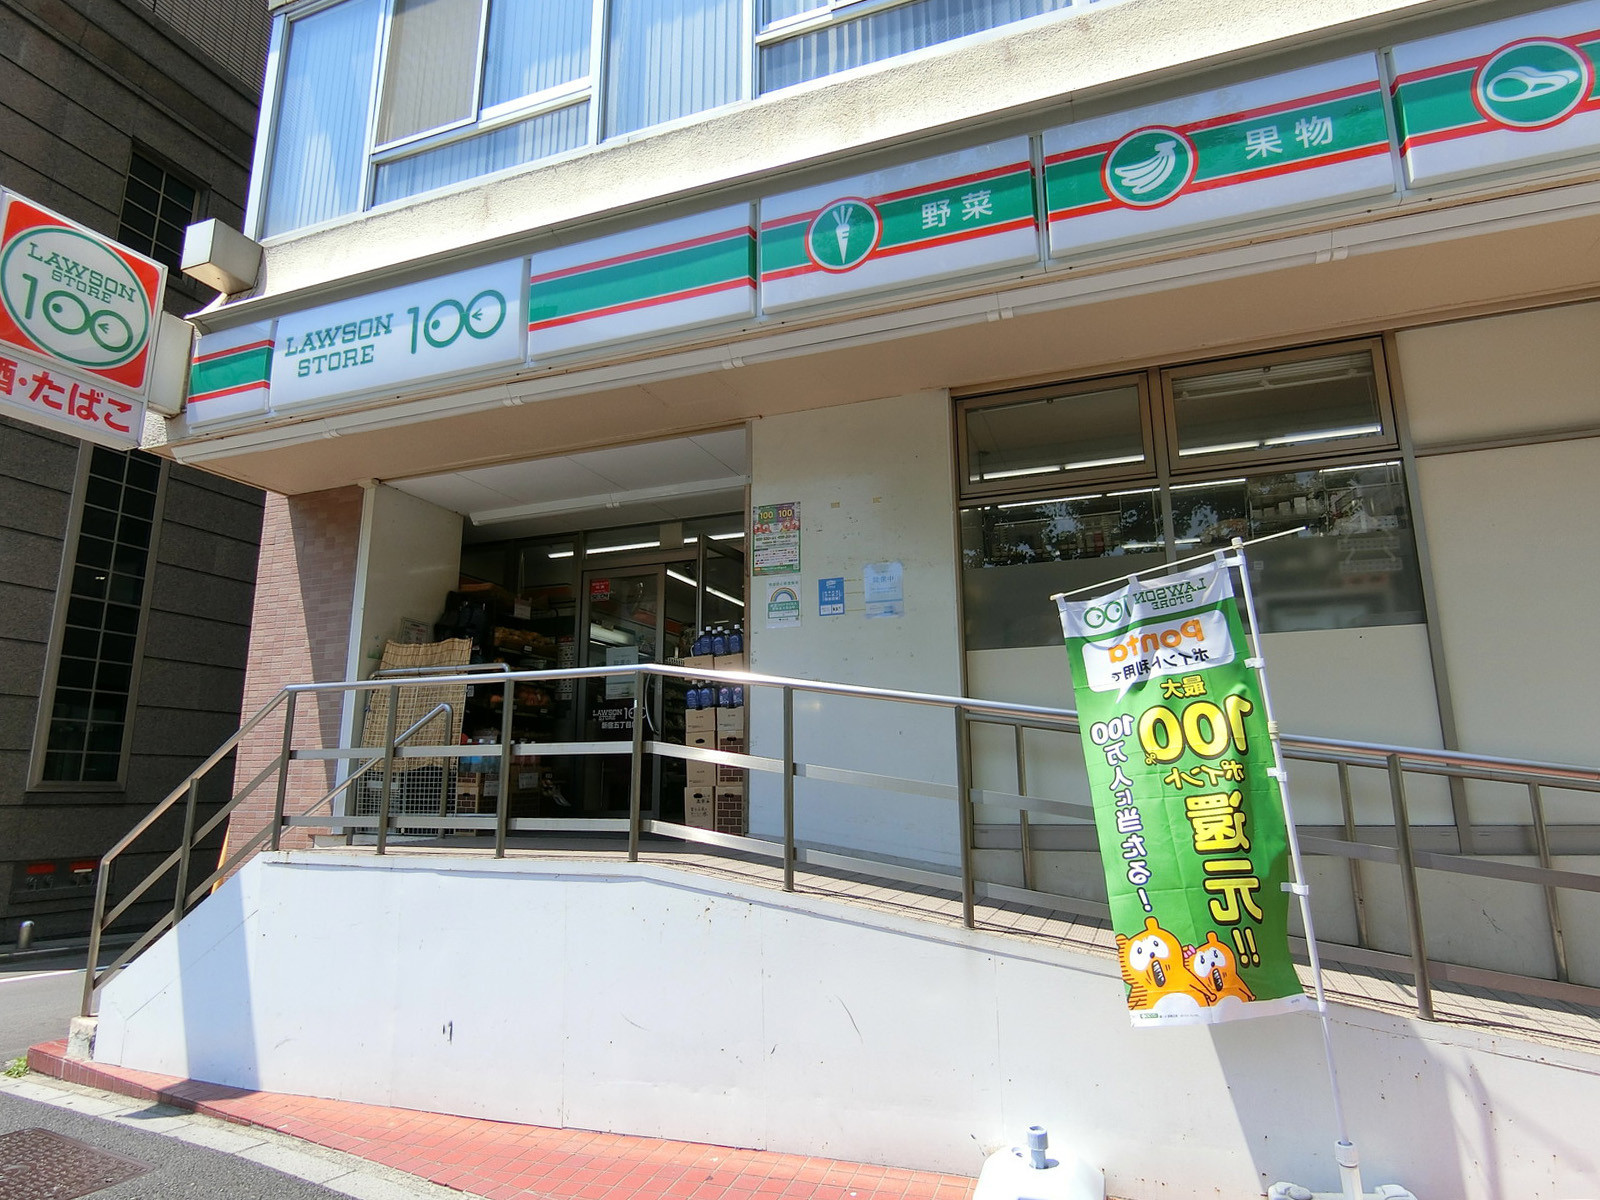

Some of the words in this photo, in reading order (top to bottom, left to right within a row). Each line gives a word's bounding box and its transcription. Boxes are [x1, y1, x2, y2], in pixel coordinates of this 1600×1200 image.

[1245, 115, 1333, 160] 果物
[922, 189, 993, 230] 野菜
[28, 242, 136, 303] LAWSON
[52, 269, 111, 304] STORE
[22, 273, 134, 353] 100
[284, 313, 395, 358] LAWSON
[407, 289, 507, 355] 100
[297, 344, 375, 378] STORE
[592, 708, 622, 717] LAWSON
